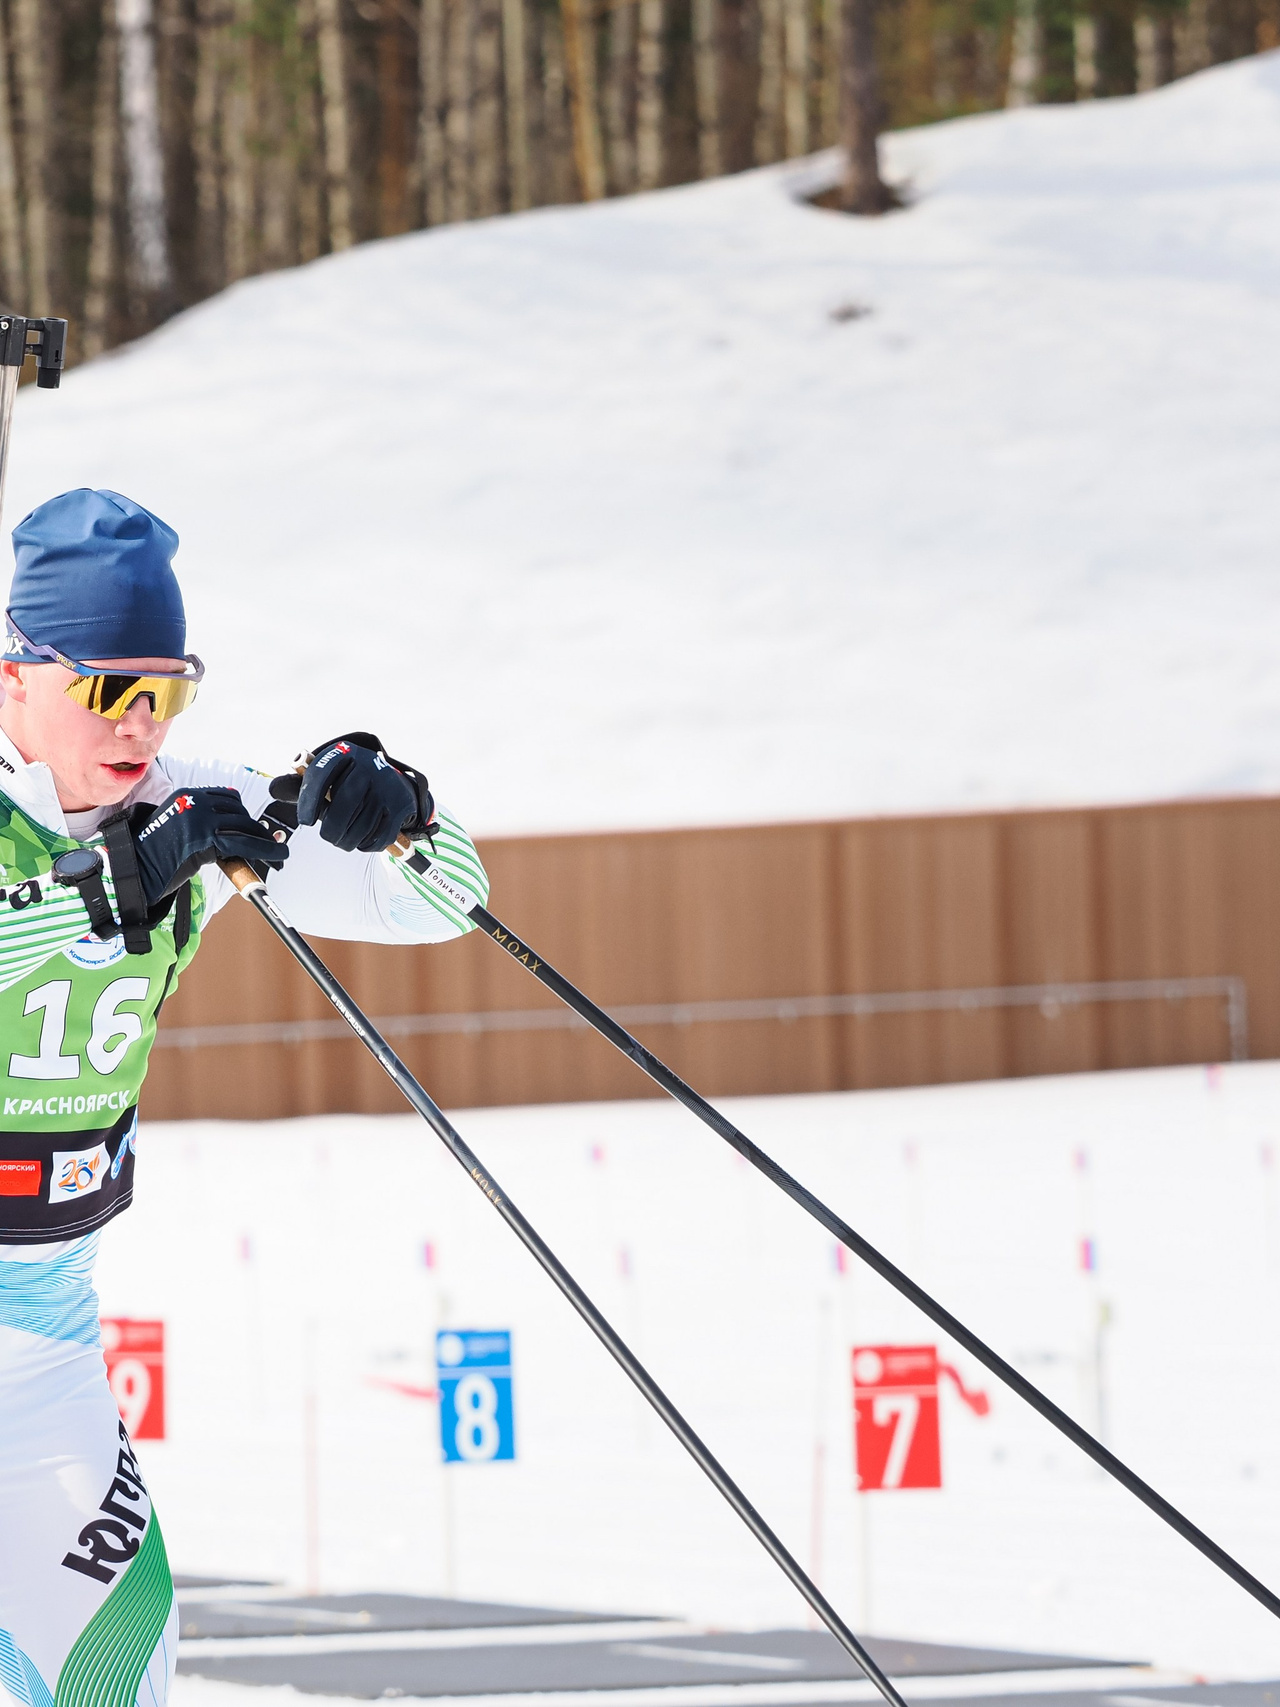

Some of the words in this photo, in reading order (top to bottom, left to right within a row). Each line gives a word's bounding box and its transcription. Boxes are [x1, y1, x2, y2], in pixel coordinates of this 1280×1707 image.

[492, 927, 542, 972] MOAX
[8, 976, 150, 1080] 16
[4, 1089, 130, 1115] КРАСНОЯРСК
[111, 1359, 151, 1440] 9
[454, 1374, 500, 1460] 8
[873, 1394, 920, 1488] 7
